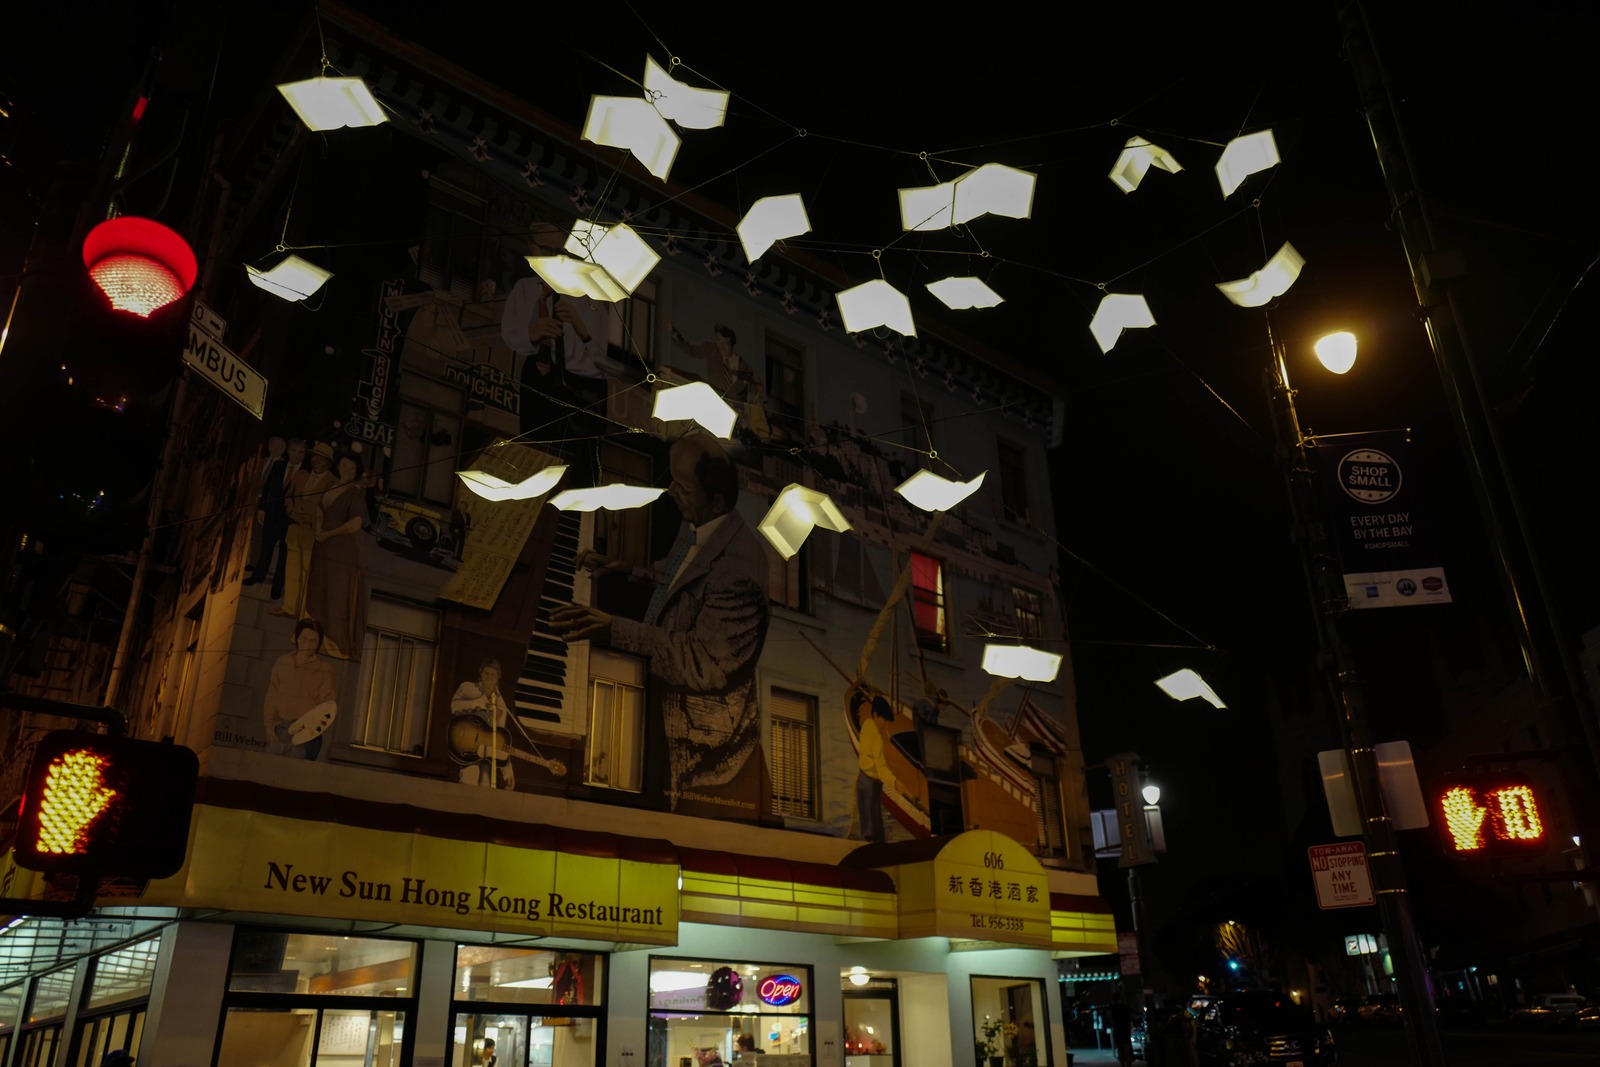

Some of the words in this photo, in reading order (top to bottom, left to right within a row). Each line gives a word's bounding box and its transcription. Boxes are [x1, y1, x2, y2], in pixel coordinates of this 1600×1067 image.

[369, 356, 386, 409] ROUGE
[1351, 466, 1388, 477] SHOP
[1348, 475, 1392, 487] SMALL
[1350, 514, 1386, 527] EVERY
[1388, 512, 1410, 524] DAY
[1353, 529, 1367, 540] BY
[1367, 527, 1391, 539] THE
[1392, 525, 1413, 537] BAY
[1364, 541, 1411, 550] #SHOPSMALL
[214, 731, 233, 743] Bill
[233, 735, 268, 749] Weber
[1115, 760, 1136, 861] HOTEL
[1313, 844, 1359, 856] TOW-AWAY
[984, 852, 1004, 870] 606
[1312, 856, 1327, 870] NO
[1329, 855, 1364, 869] STOPPING
[1331, 870, 1352, 882] ANY
[263, 861, 332, 894] New
[338, 871, 392, 902] Sun
[402, 878, 472, 915] Hong
[478, 886, 541, 921] Kong
[547, 893, 664, 926] Restaurant
[948, 874, 1039, 903] 新香港酒家
[1331, 882, 1357, 894] TIME
[970, 914, 987, 928] Tel.
[988, 915, 1024, 931] 956-3338
[760, 979, 801, 1002] Open
